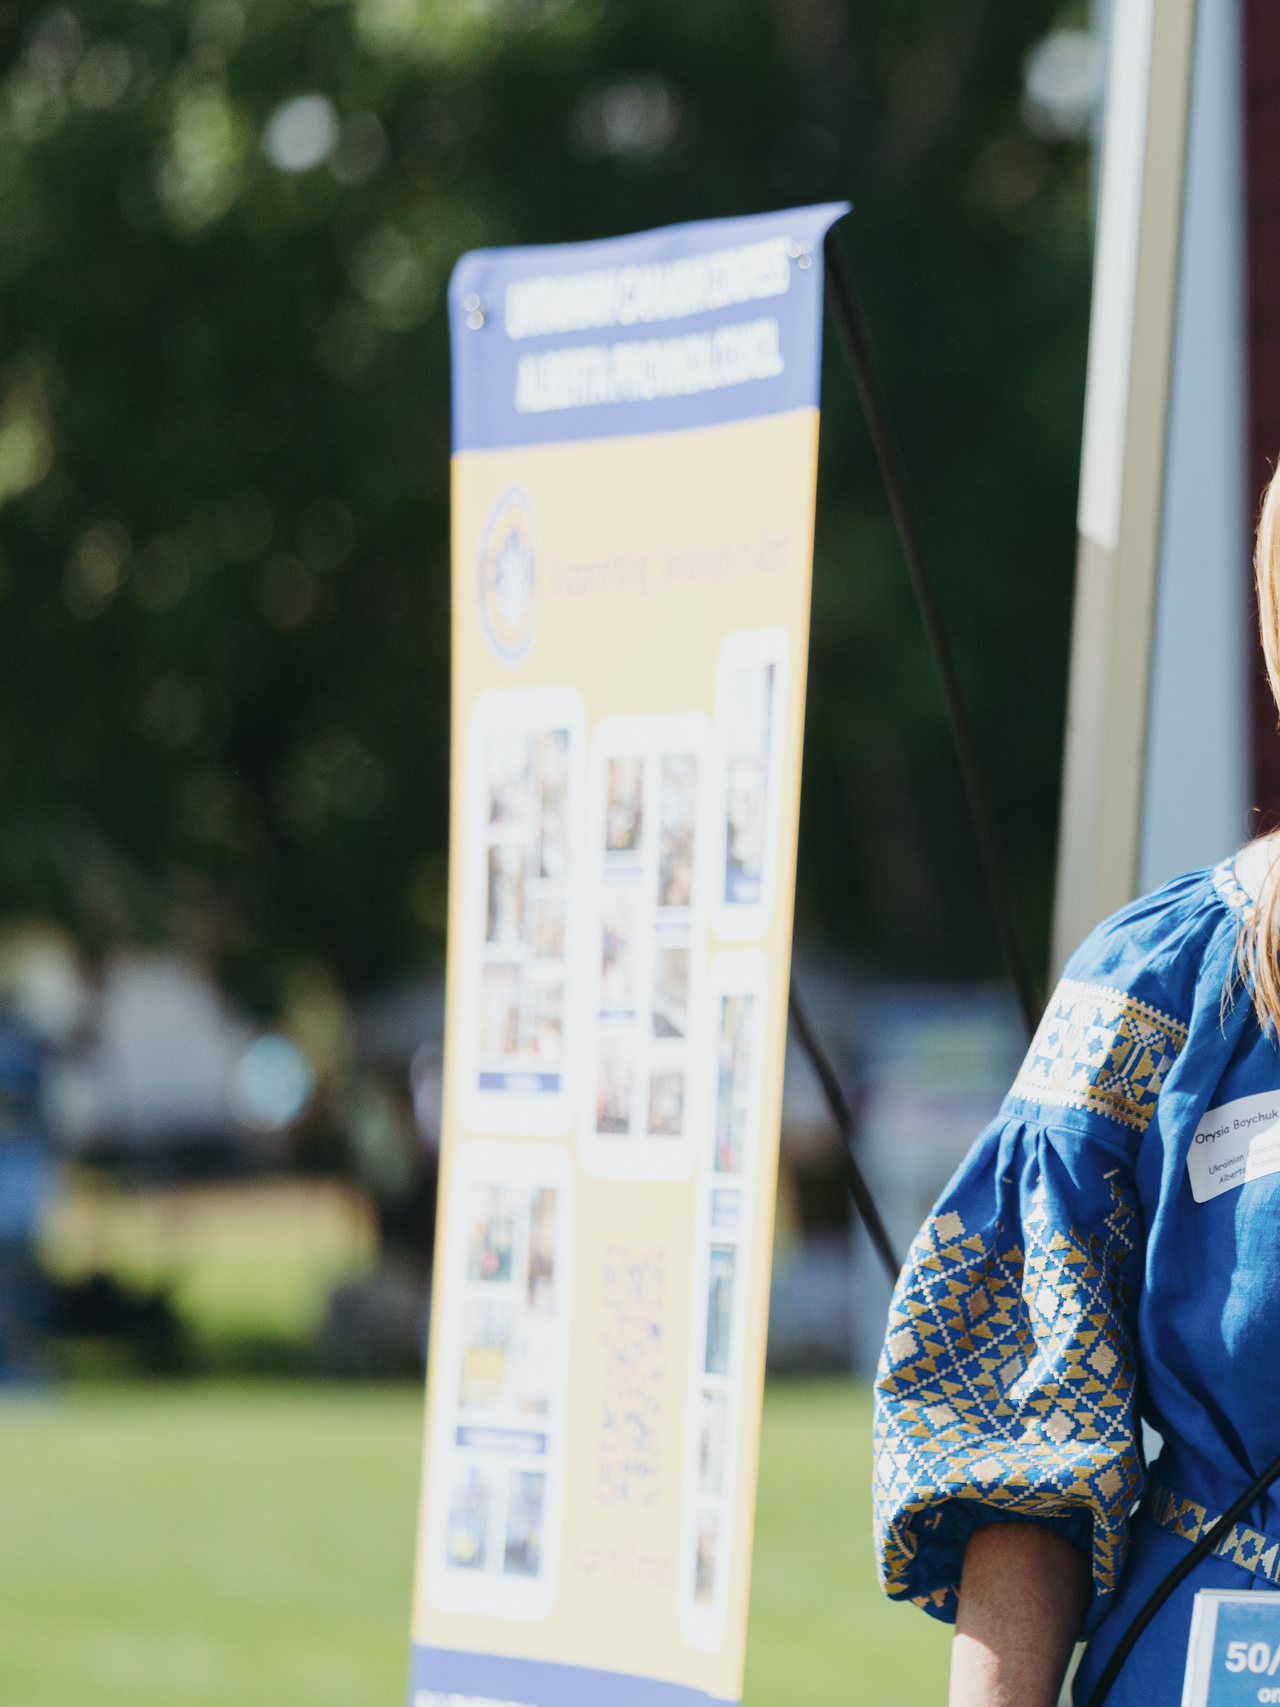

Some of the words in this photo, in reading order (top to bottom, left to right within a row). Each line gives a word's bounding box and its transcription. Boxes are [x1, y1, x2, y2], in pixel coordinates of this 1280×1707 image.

[1195, 1126, 1230, 1144] Orysia
[1208, 1154, 1245, 1175] Ukrainian
[1218, 1167, 1247, 1185] Alberta
